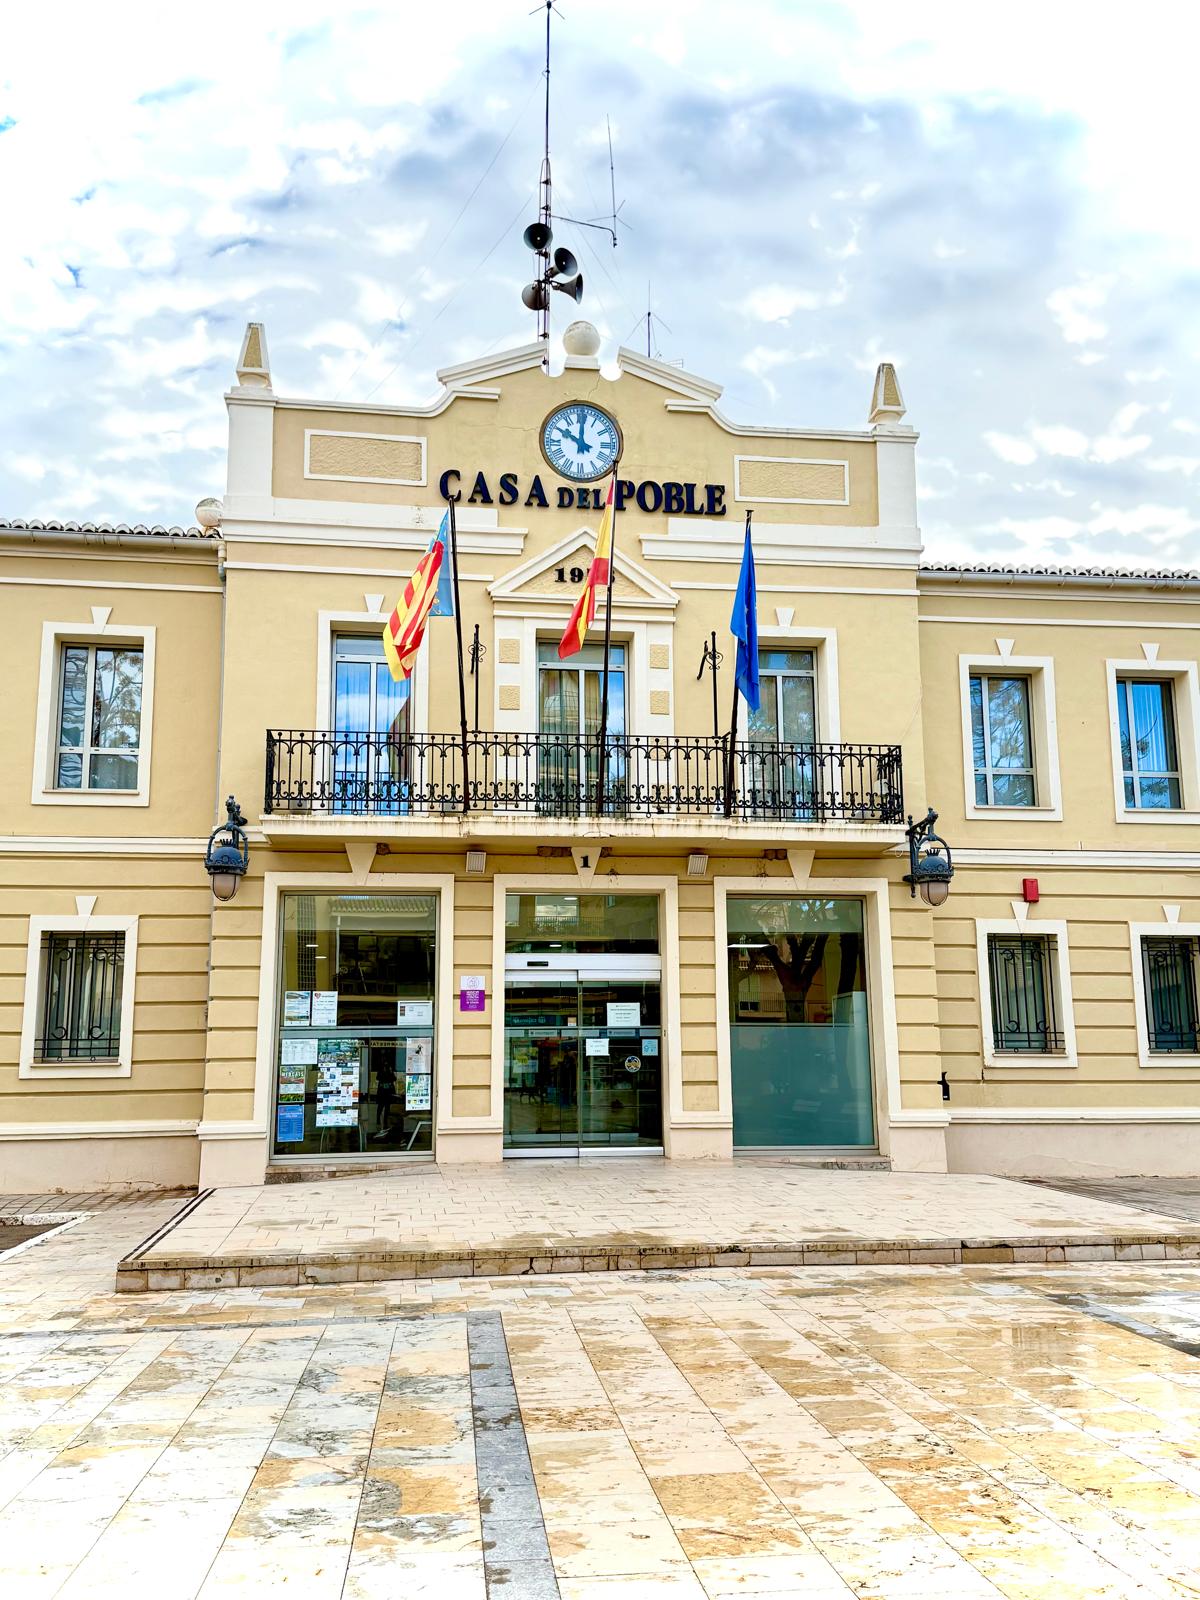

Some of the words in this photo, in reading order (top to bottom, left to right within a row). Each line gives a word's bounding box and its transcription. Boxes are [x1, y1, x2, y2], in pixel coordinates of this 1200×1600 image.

[440, 469, 549, 508] CASA
[557, 487, 605, 510] DEL
[615, 479, 727, 515] POBLE
[554, 567, 615, 584] 19
[580, 855, 591, 868] 1
